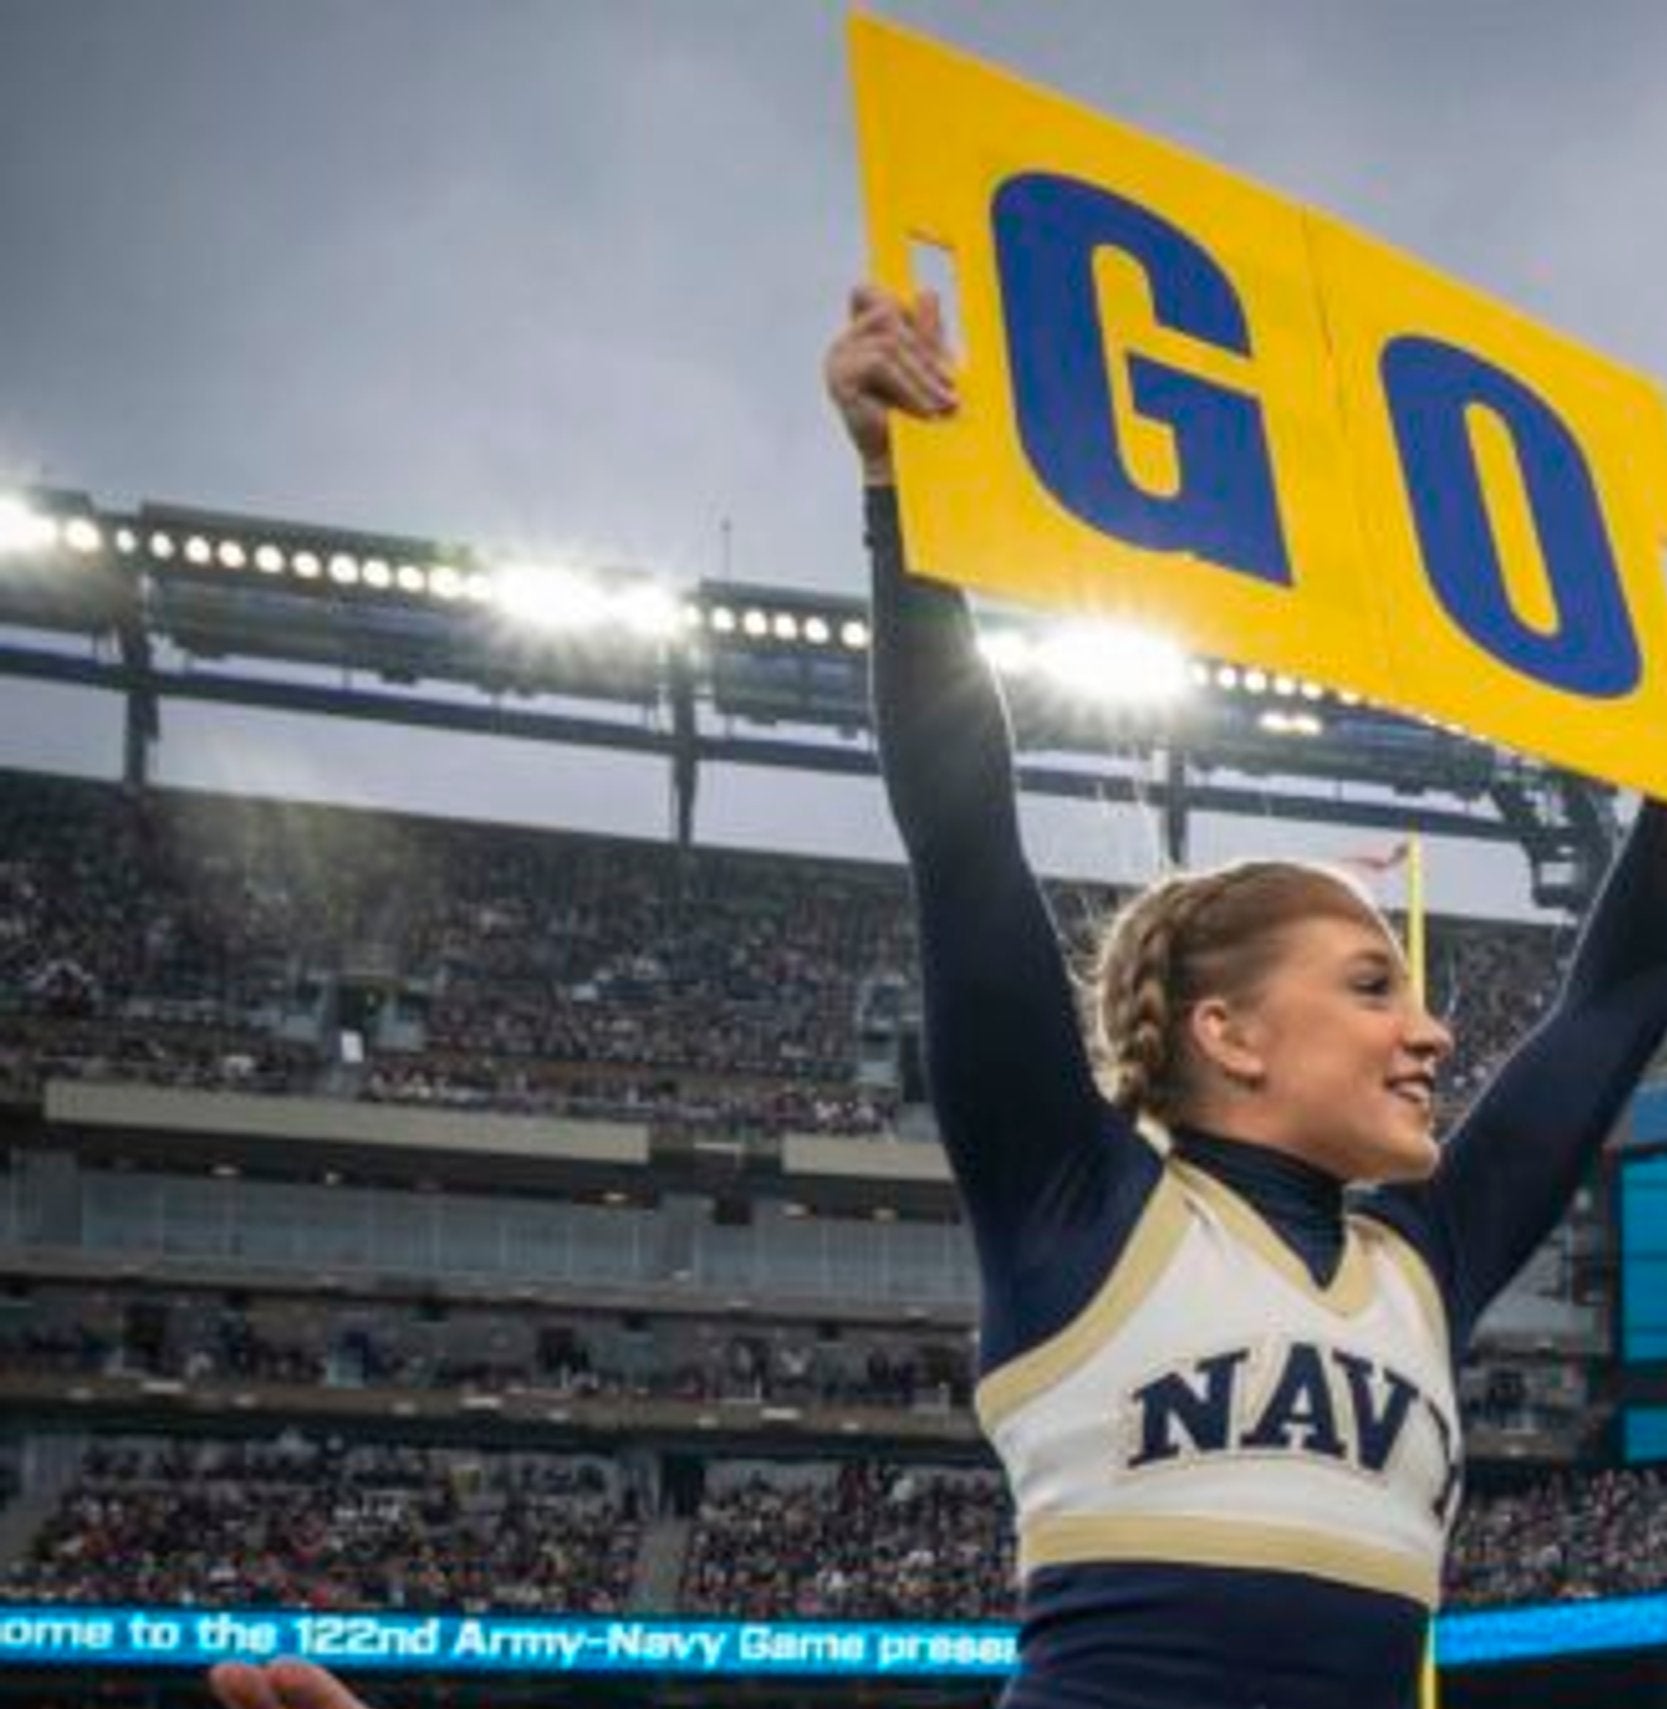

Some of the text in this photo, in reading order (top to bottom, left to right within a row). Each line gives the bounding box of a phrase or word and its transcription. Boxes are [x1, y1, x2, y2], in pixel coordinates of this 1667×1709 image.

[991, 172, 1642, 700] GO
[130, 1615, 179, 1648] to
[197, 1613, 277, 1653] the
[296, 1616, 439, 1655] 122nd
[454, 1620, 725, 1670] Army-Navy
[739, 1625, 866, 1661] Game
